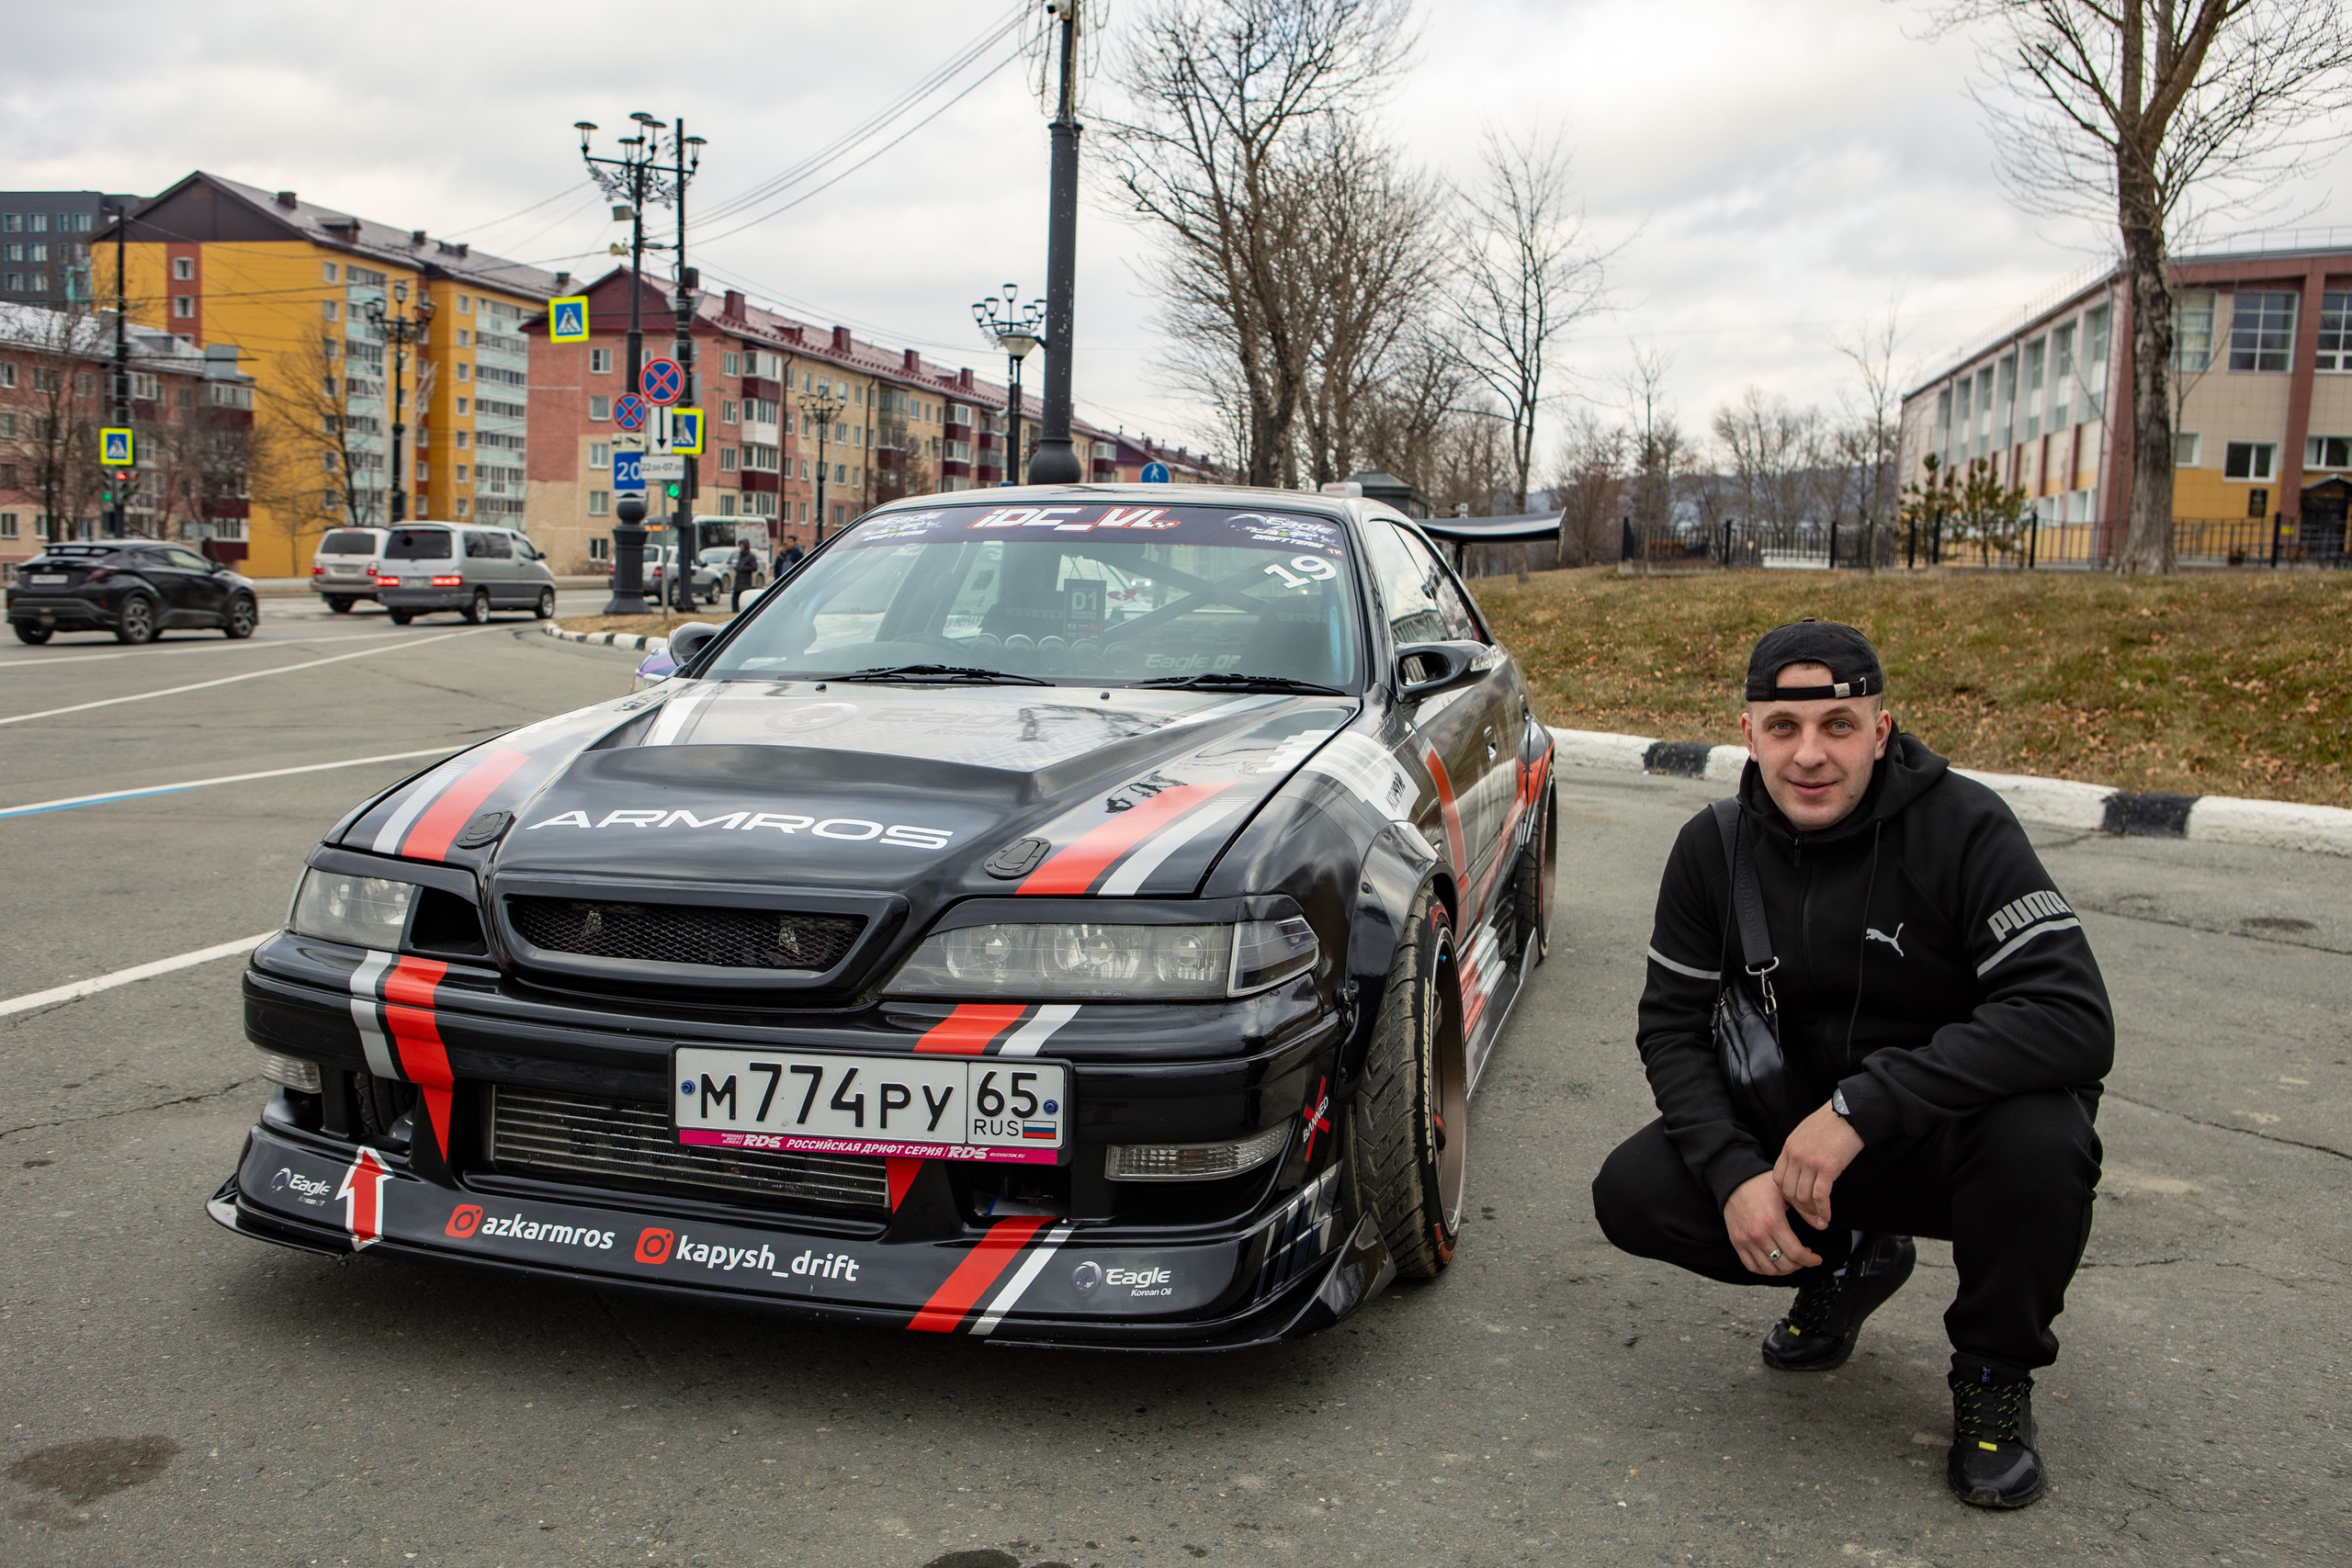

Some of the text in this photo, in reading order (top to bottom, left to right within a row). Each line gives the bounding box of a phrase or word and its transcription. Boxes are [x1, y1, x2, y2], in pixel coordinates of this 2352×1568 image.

[616, 462, 641, 480] 20
[1265, 515, 1337, 534] Eagle
[1263, 555, 1337, 589] 19
[1071, 591, 1097, 611] D1
[1145, 653, 1209, 671] Eagle
[526, 809, 954, 850] ARMROS
[1987, 890, 2074, 942] PUMA
[978, 1071, 1038, 1119] 65
[974, 1119, 1020, 1136] RUS
[1303, 1096, 1329, 1143] BANNED
[743, 1134, 784, 1148] RDS
[786, 1139, 944, 1156] РОССИЙСКАЯ ДРИФТ СЕРИЯ
[947, 1146, 989, 1159] RDS
[289, 1174, 332, 1196] Eagle
[481, 1213, 615, 1250] azkarmros
[675, 1235, 859, 1282] kapysh_drift
[1106, 1268, 1171, 1288] Eagle
[1160, 1288, 1172, 1296] Oil
